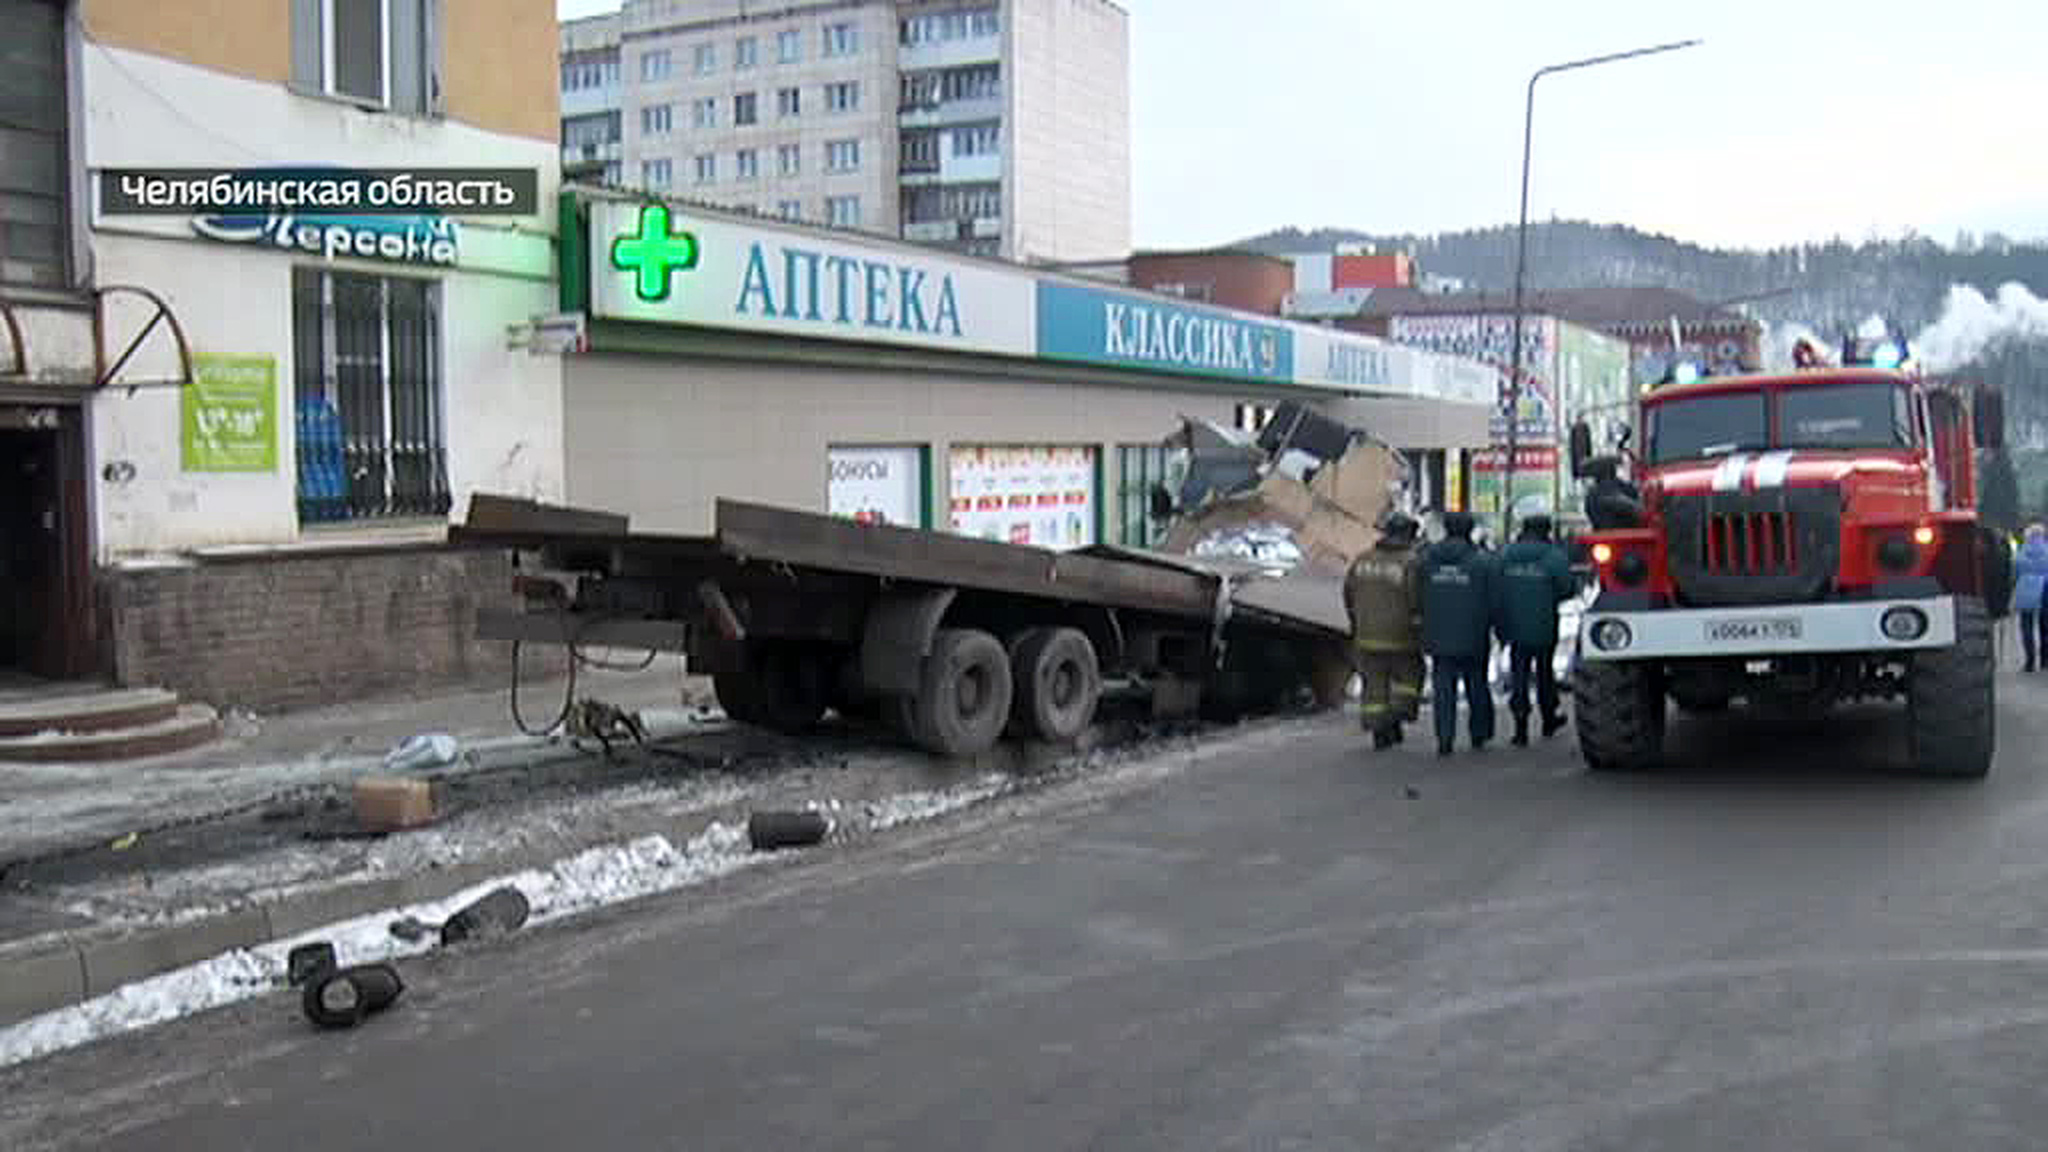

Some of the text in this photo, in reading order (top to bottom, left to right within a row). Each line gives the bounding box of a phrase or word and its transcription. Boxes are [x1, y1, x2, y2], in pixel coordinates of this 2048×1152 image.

[736, 240, 963, 338] АПТЕКА
[1104, 301, 1255, 370] КЛАССИКА
[1326, 342, 1392, 386] АПТЕКА
